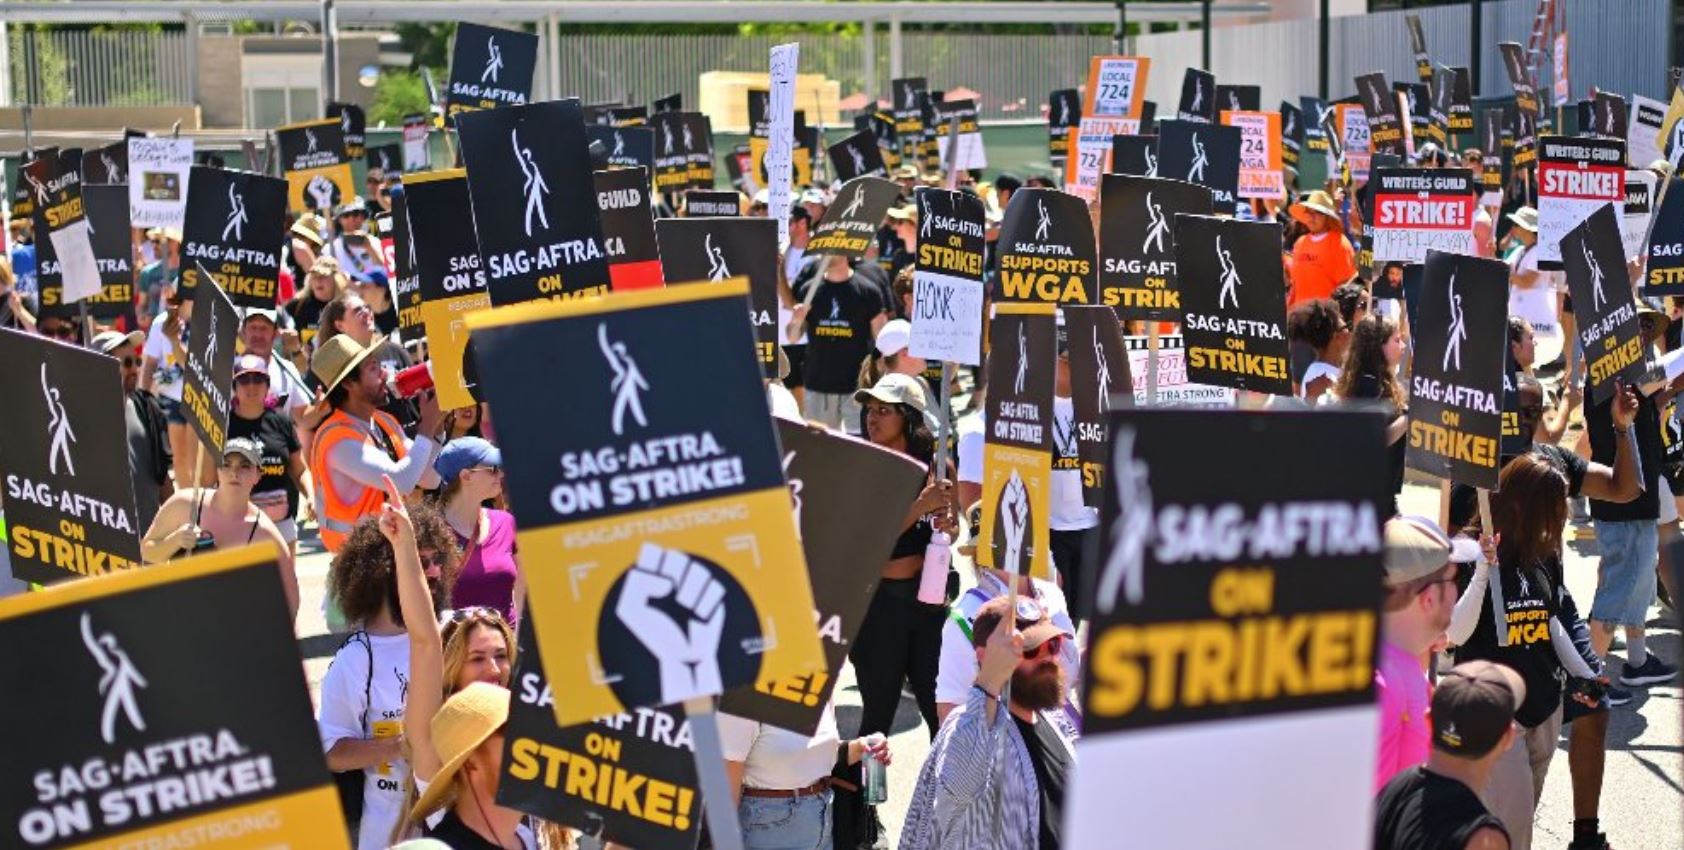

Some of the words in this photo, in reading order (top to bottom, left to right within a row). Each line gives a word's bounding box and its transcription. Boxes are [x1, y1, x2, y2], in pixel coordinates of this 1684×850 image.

[1102, 72, 1131, 82] LOCAL
[1101, 84, 1130, 100] 724
[1241, 128, 1264, 136] OCAL
[1347, 127, 1368, 141] 724
[1241, 139, 1264, 154] 24
[1545, 144, 1590, 160] WRITERS
[1592, 147, 1620, 162] GUILD
[1382, 176, 1432, 190] WRITERS
[1434, 178, 1466, 190] GUILD
[1544, 169, 1618, 198] STRIKE!
[598, 188, 641, 210] GUILD
[1380, 200, 1466, 226] STRIKE!
[808, 237, 869, 251] STRIKE!
[949, 235, 962, 248] ON
[221, 262, 240, 274] ON
[920, 244, 982, 276] STRIKE!
[1001, 255, 1090, 274] SUPPORTS
[1105, 258, 1177, 276] SAG·AFT
[182, 268, 275, 298] SRIKE!
[443, 273, 470, 292] ON
[538, 274, 563, 293] ON
[1001, 271, 1088, 304] WGA
[1145, 277, 1166, 289] ON
[916, 279, 955, 322] HONK
[1103, 287, 1180, 308] STRIK
[815, 327, 853, 338] STRONG
[1605, 335, 1617, 350] ON
[1225, 337, 1245, 350] ON
[1189, 346, 1288, 380] STRIKE!
[1590, 335, 1643, 387] STRIKE!
[1183, 388, 1225, 400] STRONG
[184, 383, 224, 450] STRIKE!
[1441, 410, 1459, 427] ON
[994, 421, 1009, 439] ON
[1010, 421, 1043, 444] STRIKE!
[1409, 420, 1497, 468] STRIKE!
[550, 482, 604, 515] ON
[609, 457, 746, 505] STRIKE!
[59, 519, 85, 541] ON
[562, 502, 749, 550] #SAGAFTRASTRONG
[12, 525, 141, 577] STRIKE
[1210, 567, 1275, 617] ON
[1505, 609, 1549, 623] UPPORT
[1088, 610, 1376, 717] STRIKE!
[521, 674, 695, 752] SAAFTRA
[585, 732, 622, 761] ON
[509, 737, 695, 832] STRIKE!
[19, 800, 92, 844] ON
[99, 755, 277, 826] STRIKE!
